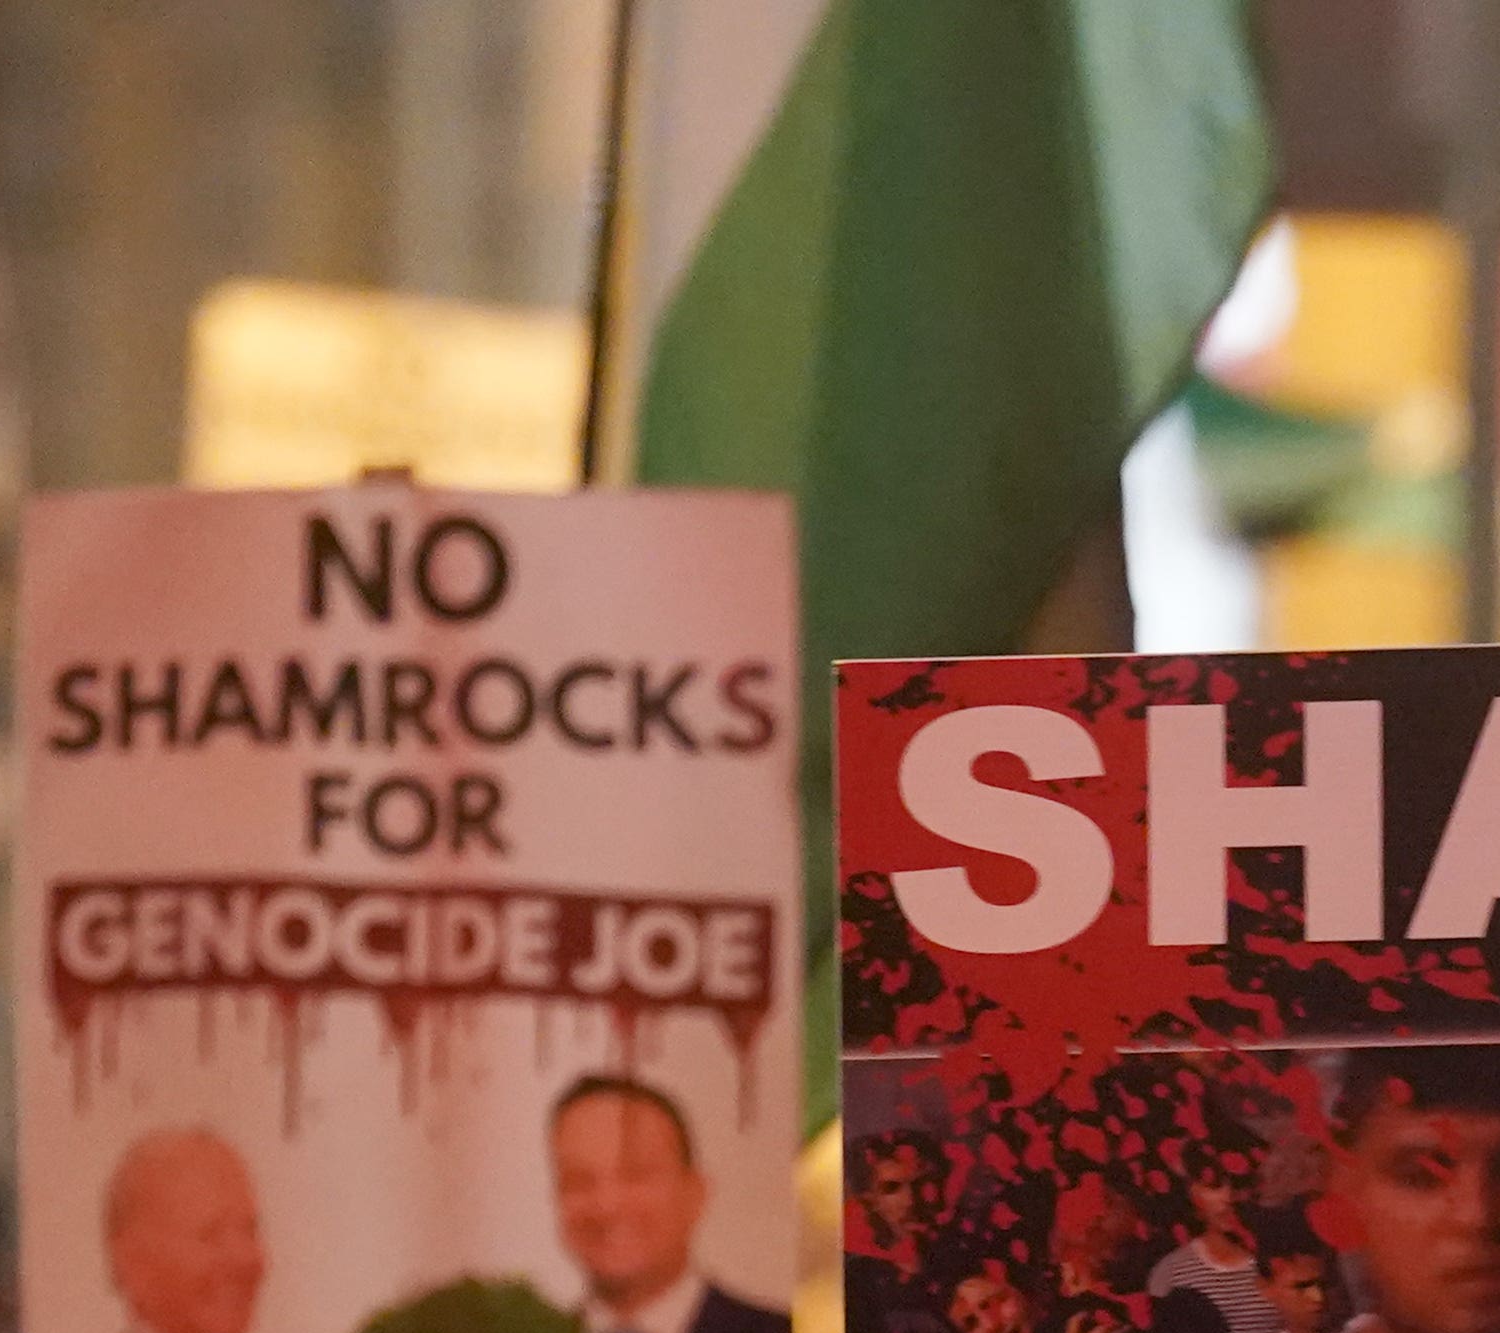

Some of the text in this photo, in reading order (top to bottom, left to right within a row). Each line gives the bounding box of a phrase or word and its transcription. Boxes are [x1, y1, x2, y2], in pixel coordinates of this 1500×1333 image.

[303, 513, 512, 624] NO
[48, 655, 778, 755] SHAMROCKS
[303, 772, 512, 857] FOR
[57, 886, 762, 999] GENOCIDE JOE
